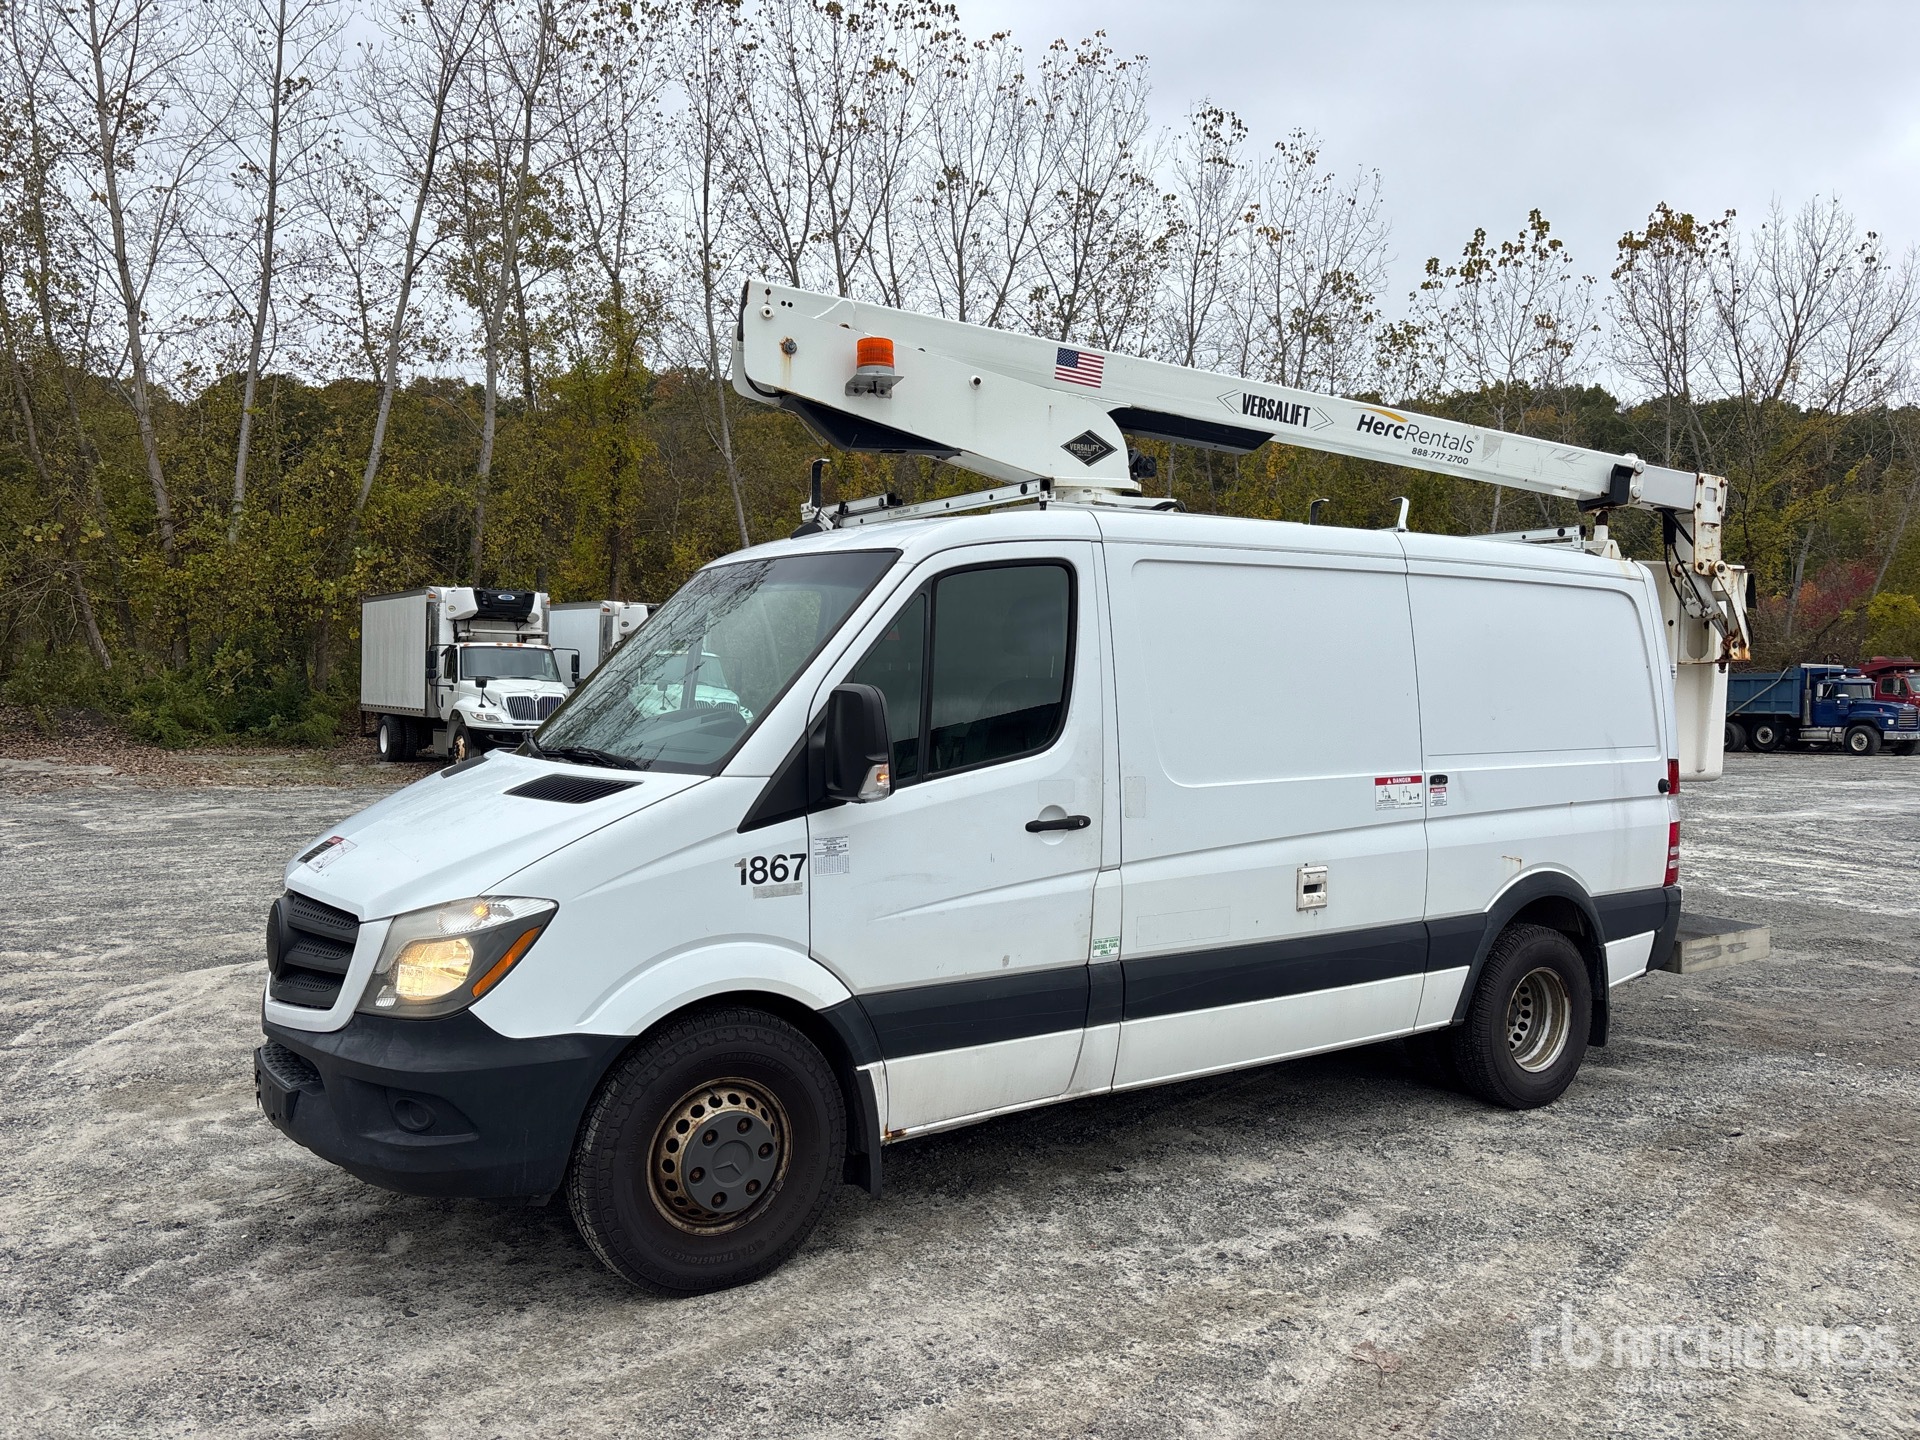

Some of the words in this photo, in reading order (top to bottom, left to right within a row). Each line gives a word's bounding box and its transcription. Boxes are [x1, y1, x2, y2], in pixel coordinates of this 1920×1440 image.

[1242, 393, 1311, 427] VERSALIFT
[1411, 447, 1469, 465] 888-777-2700
[734, 853, 807, 885] 1867
[673, 1251, 735, 1265] TRANSFORCE
